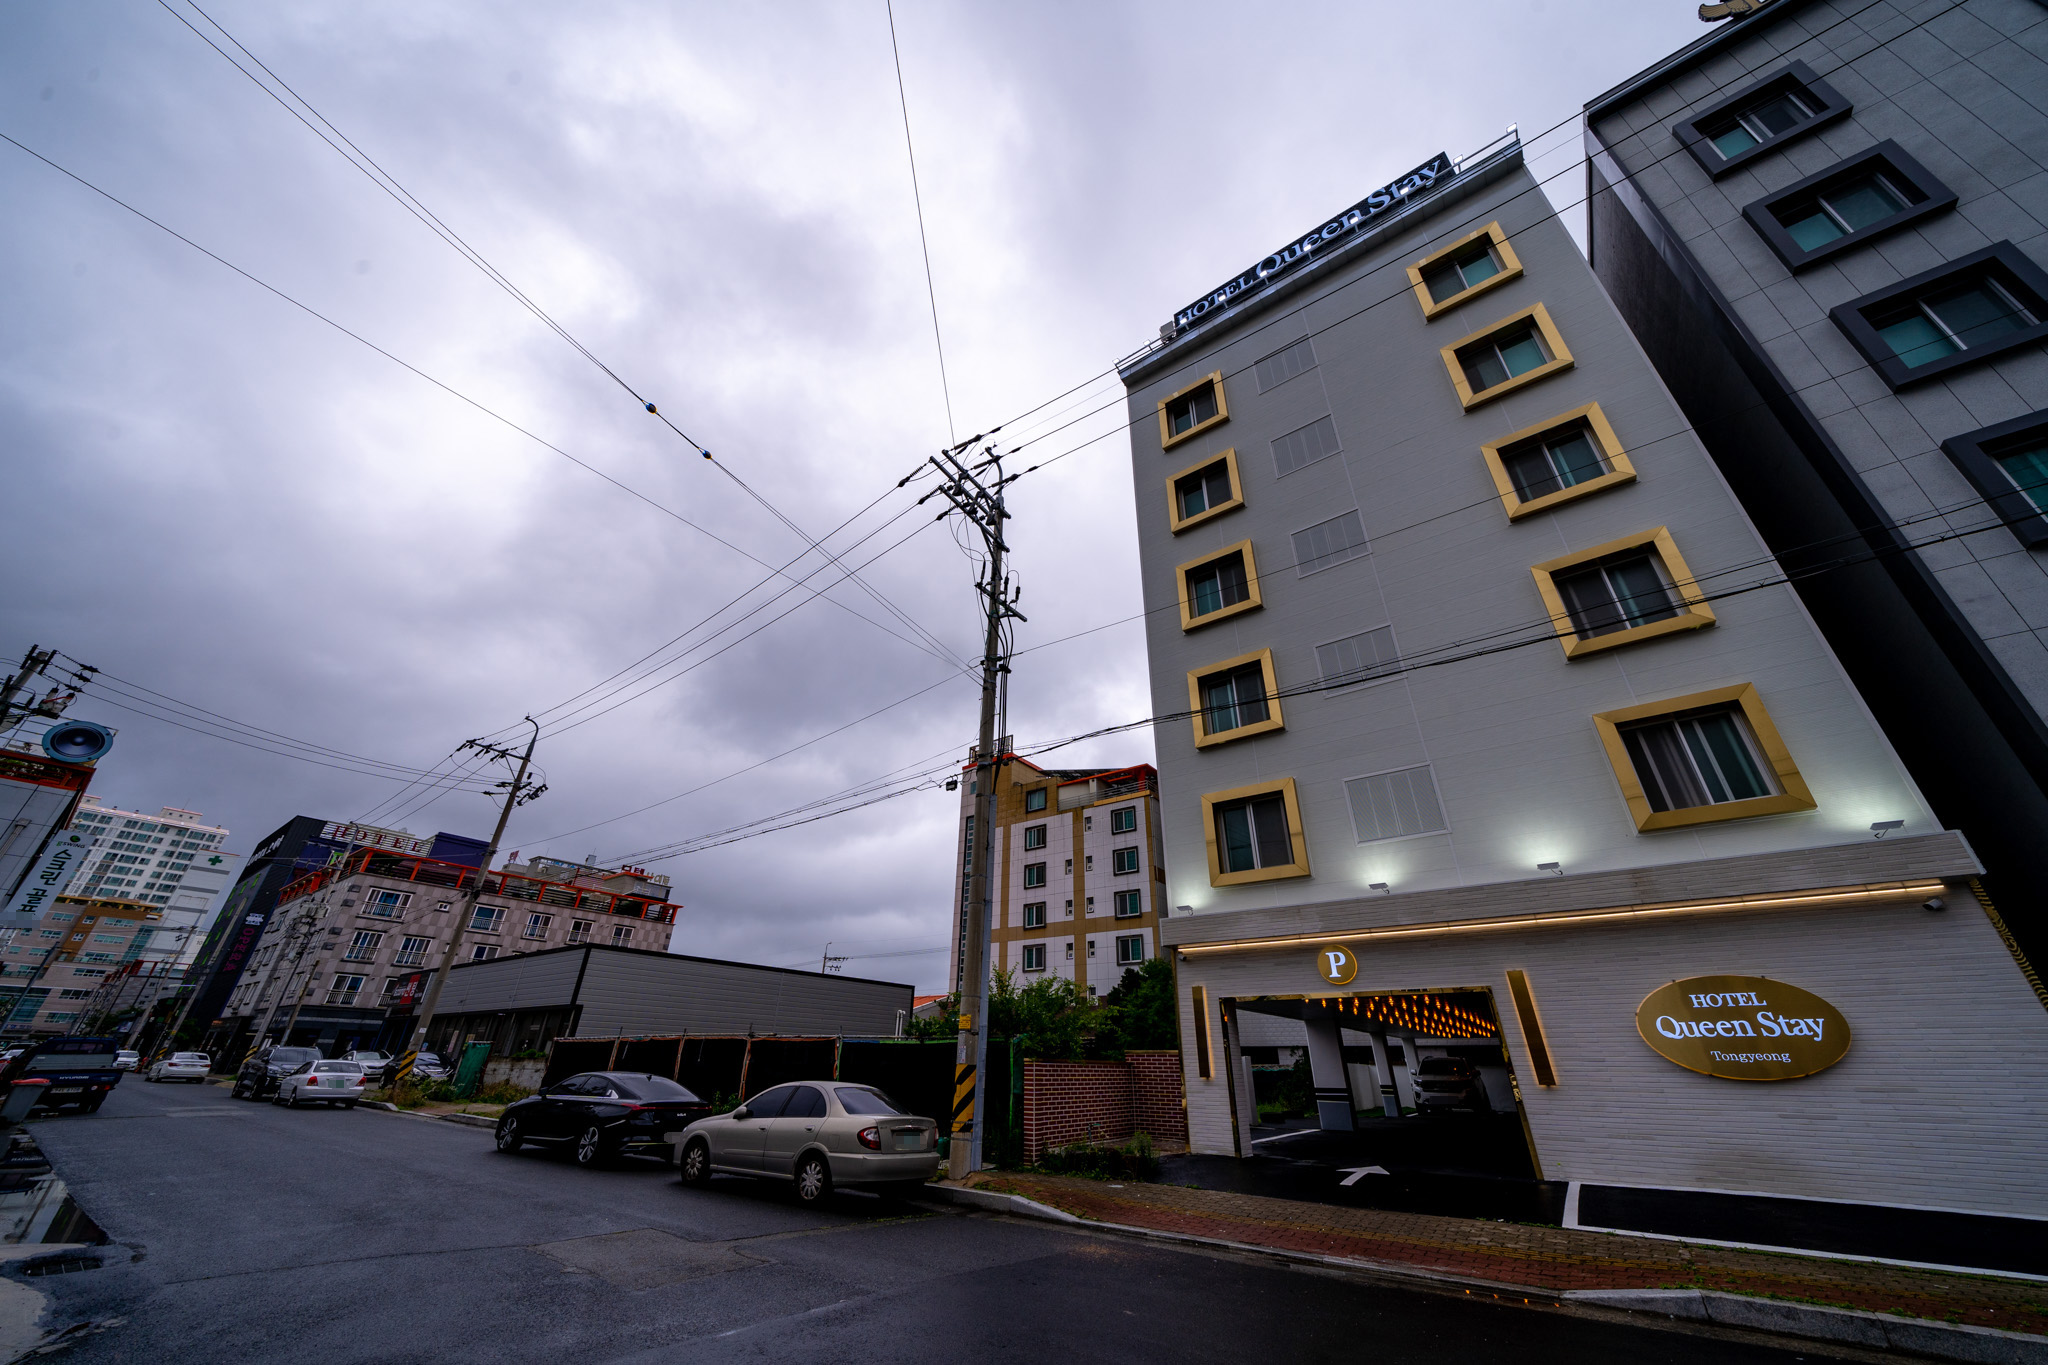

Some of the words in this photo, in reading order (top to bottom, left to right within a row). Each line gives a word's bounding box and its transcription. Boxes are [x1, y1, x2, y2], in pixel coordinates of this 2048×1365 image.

[1176, 276, 1254, 327] HOTEL
[1255, 209, 1365, 278] Queen
[1367, 160, 1441, 214] Stay
[332, 825, 422, 853] HOTEL
[1325, 952, 1346, 977] P
[1689, 992, 1767, 1008] HOTEL
[1656, 1015, 1757, 1040] Queen
[1757, 1011, 1825, 1042] Stay
[1711, 1051, 1792, 1063] Tongyeong
